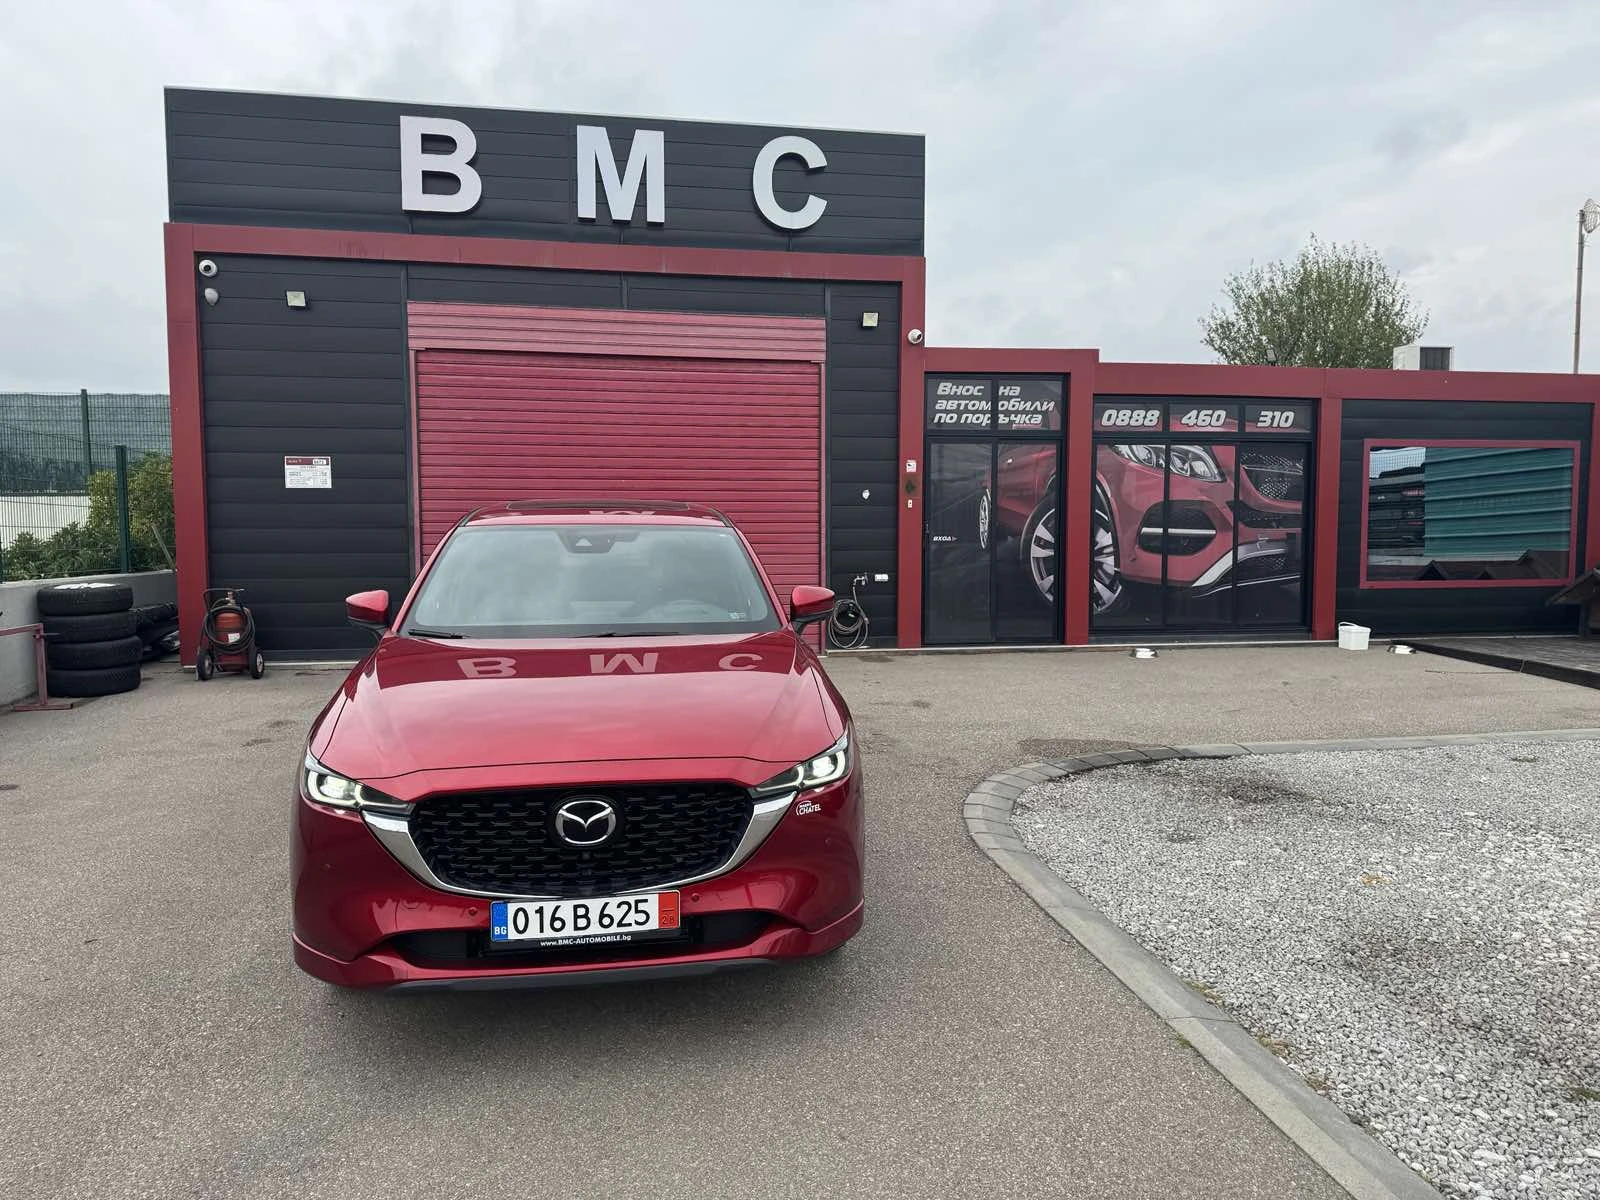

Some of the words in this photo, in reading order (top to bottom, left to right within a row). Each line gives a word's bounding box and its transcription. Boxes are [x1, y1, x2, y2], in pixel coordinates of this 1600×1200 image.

[937, 382, 985, 396] Внос
[998, 386, 1021, 396] на
[933, 413, 957, 424] по
[1101, 409, 1160, 427] 0888
[1181, 409, 1226, 427] 460
[1257, 410, 1295, 428] 310
[494, 927, 507, 935] BG
[540, 934, 632, 947] www.BMC-AUTOMOBILE.bg
